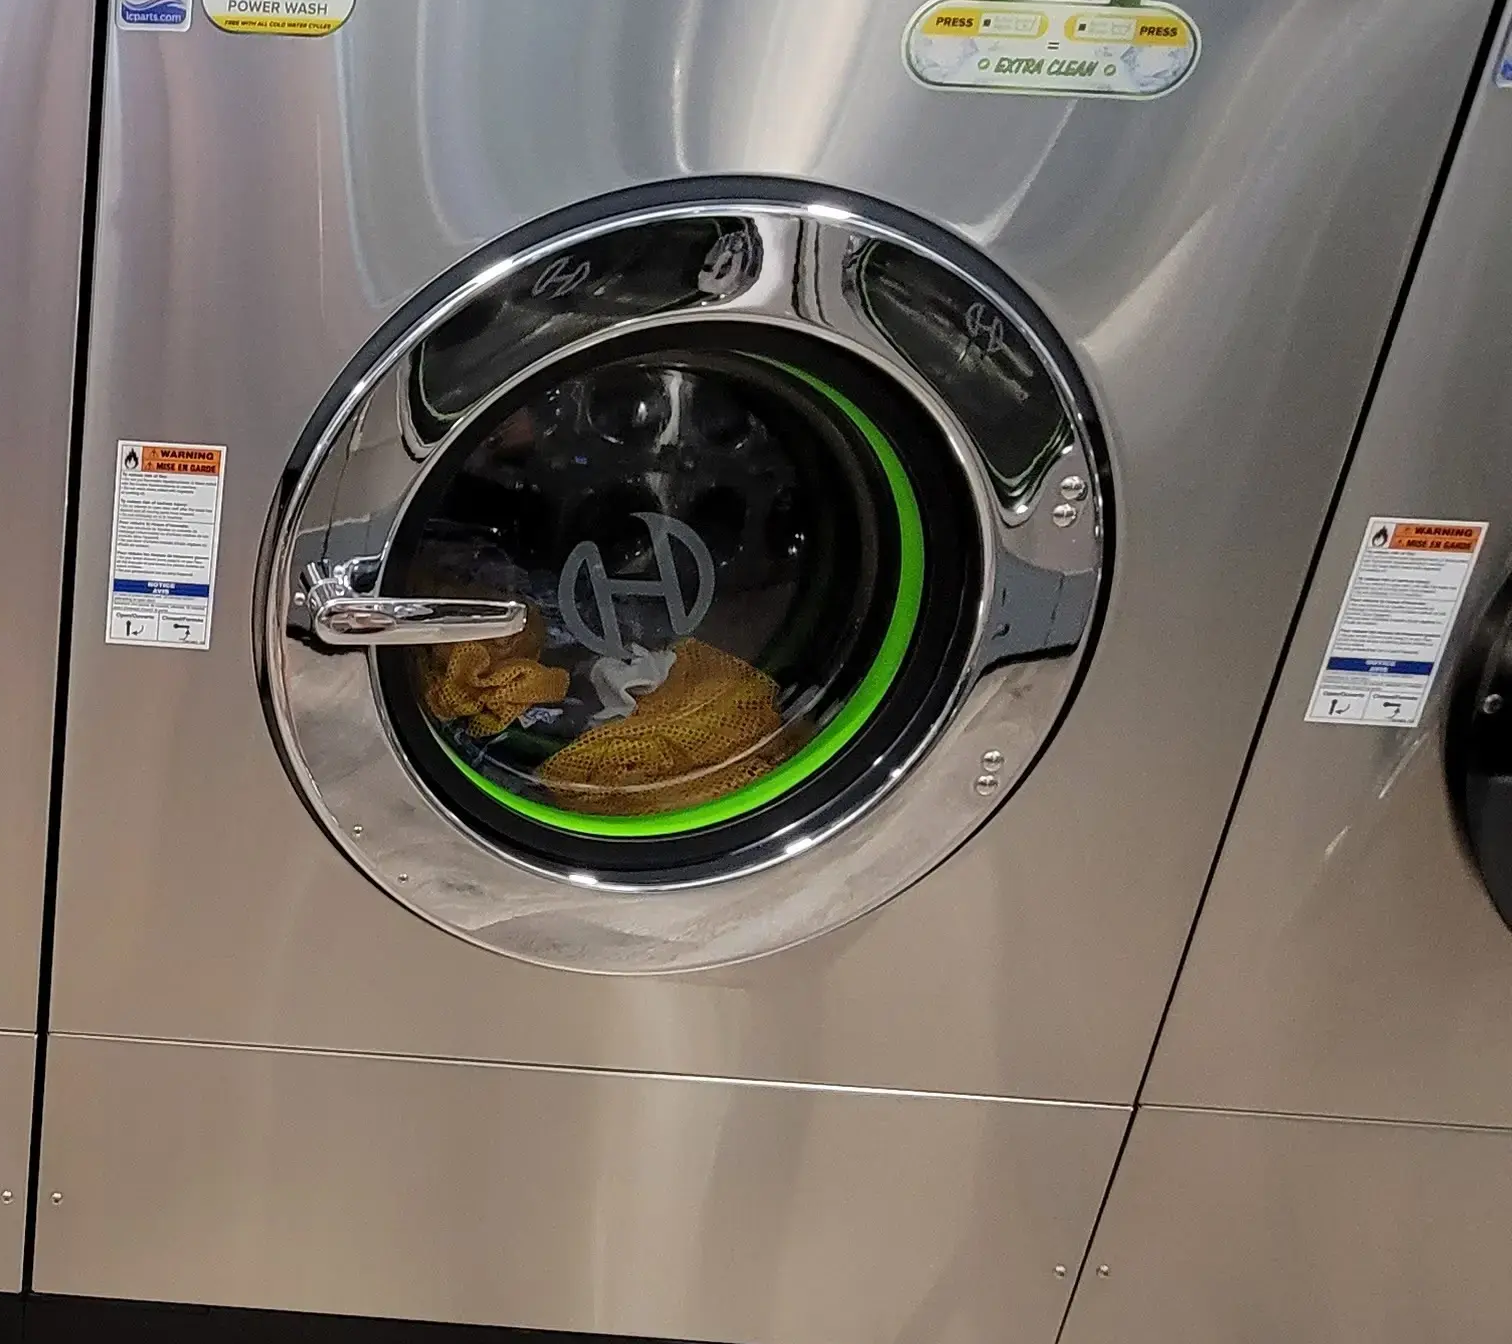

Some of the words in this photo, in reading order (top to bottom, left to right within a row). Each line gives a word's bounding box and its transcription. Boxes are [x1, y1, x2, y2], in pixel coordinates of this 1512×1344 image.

[228, 0, 281, 14] POWER
[285, 0, 328, 15] WASH
[125, 11, 182, 23] lcparts.com
[936, 16, 974, 28] PRESS
[1139, 25, 1178, 38] PRESS
[994, 57, 1042, 74] EXTRA
[1046, 59, 1096, 76] CLEAN
[160, 449, 214, 461] WARNING
[156, 462, 176, 471] MISE
[191, 463, 217, 474] GARDE
[1415, 527, 1473, 537] WARNING
